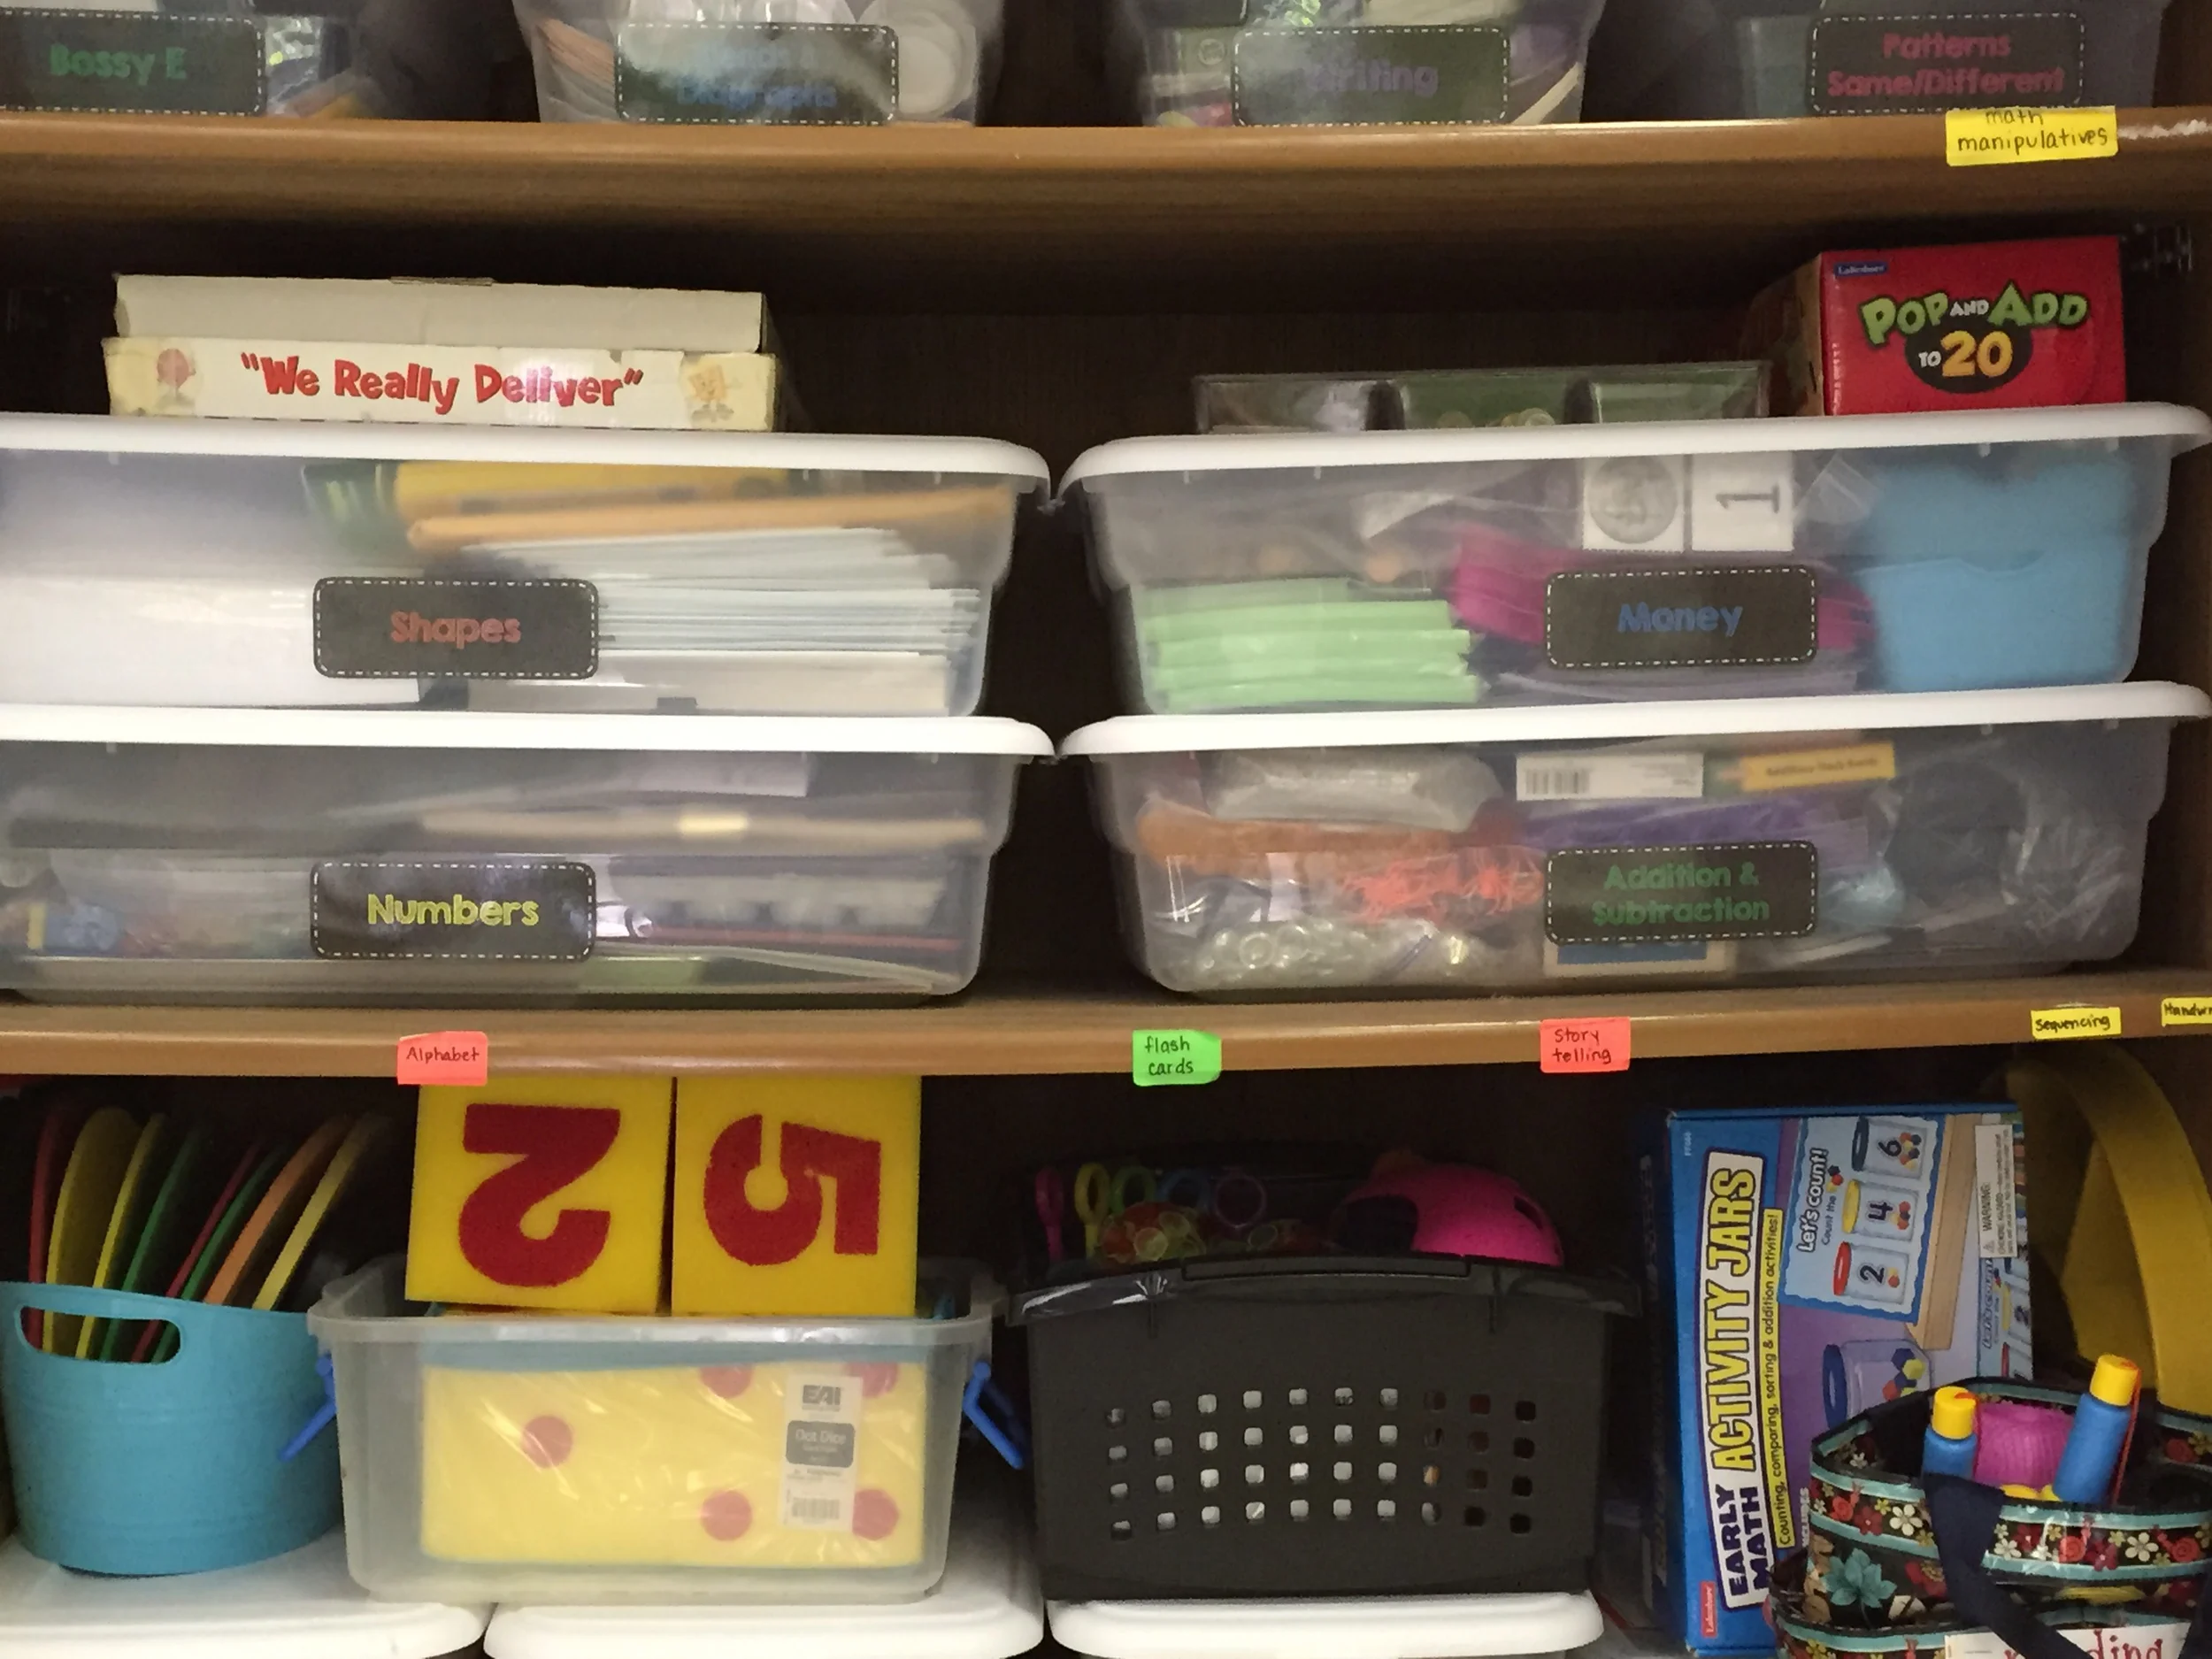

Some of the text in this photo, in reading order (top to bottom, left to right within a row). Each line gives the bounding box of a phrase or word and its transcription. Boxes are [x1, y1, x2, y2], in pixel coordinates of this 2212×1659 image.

[1882, 32, 2011, 59] Patterns
[50, 43, 187, 86] Bossy E
[1827, 66, 2066, 96] Same/Different
[1985, 109, 2045, 126] math
[1956, 127, 2108, 156] manipulatives
[1859, 279, 2088, 346] POP AND ADD
[1918, 329, 2013, 378] TO 20
[334, 358, 460, 415] Really
[390, 611, 521, 649] Shapes
[1617, 601, 1743, 637] Money
[1604, 861, 1761, 891] Addition &
[367, 893, 540, 926] Numbers
[1593, 895, 1770, 927] Subtraction
[1554, 1026, 1601, 1046] Story
[2035, 1014, 2111, 1033] Sequencing
[406, 1046, 480, 1065] Alphabet
[1144, 1035, 1190, 1054] flash
[1551, 1048, 1612, 1065] telling
[1148, 1056, 1194, 1076] cards
[1877, 1139, 1902, 1157] 6
[458, 1102, 621, 1287] 2
[703, 1113, 881, 1266] 5
[1796, 1148, 1830, 1252] Let's count!
[1821, 1195, 1837, 1246] Count the
[1867, 1200, 1894, 1223] 4
[1859, 1263, 1886, 1284] 2
[1704, 1167, 1757, 1474] ACTIVITY JARS
[1763, 1213, 1793, 1546] Counting, comparing, sorting & addition activities!
[1713, 1483, 1749, 1597] EARLY
[1739, 1486, 1770, 1592] MATH
